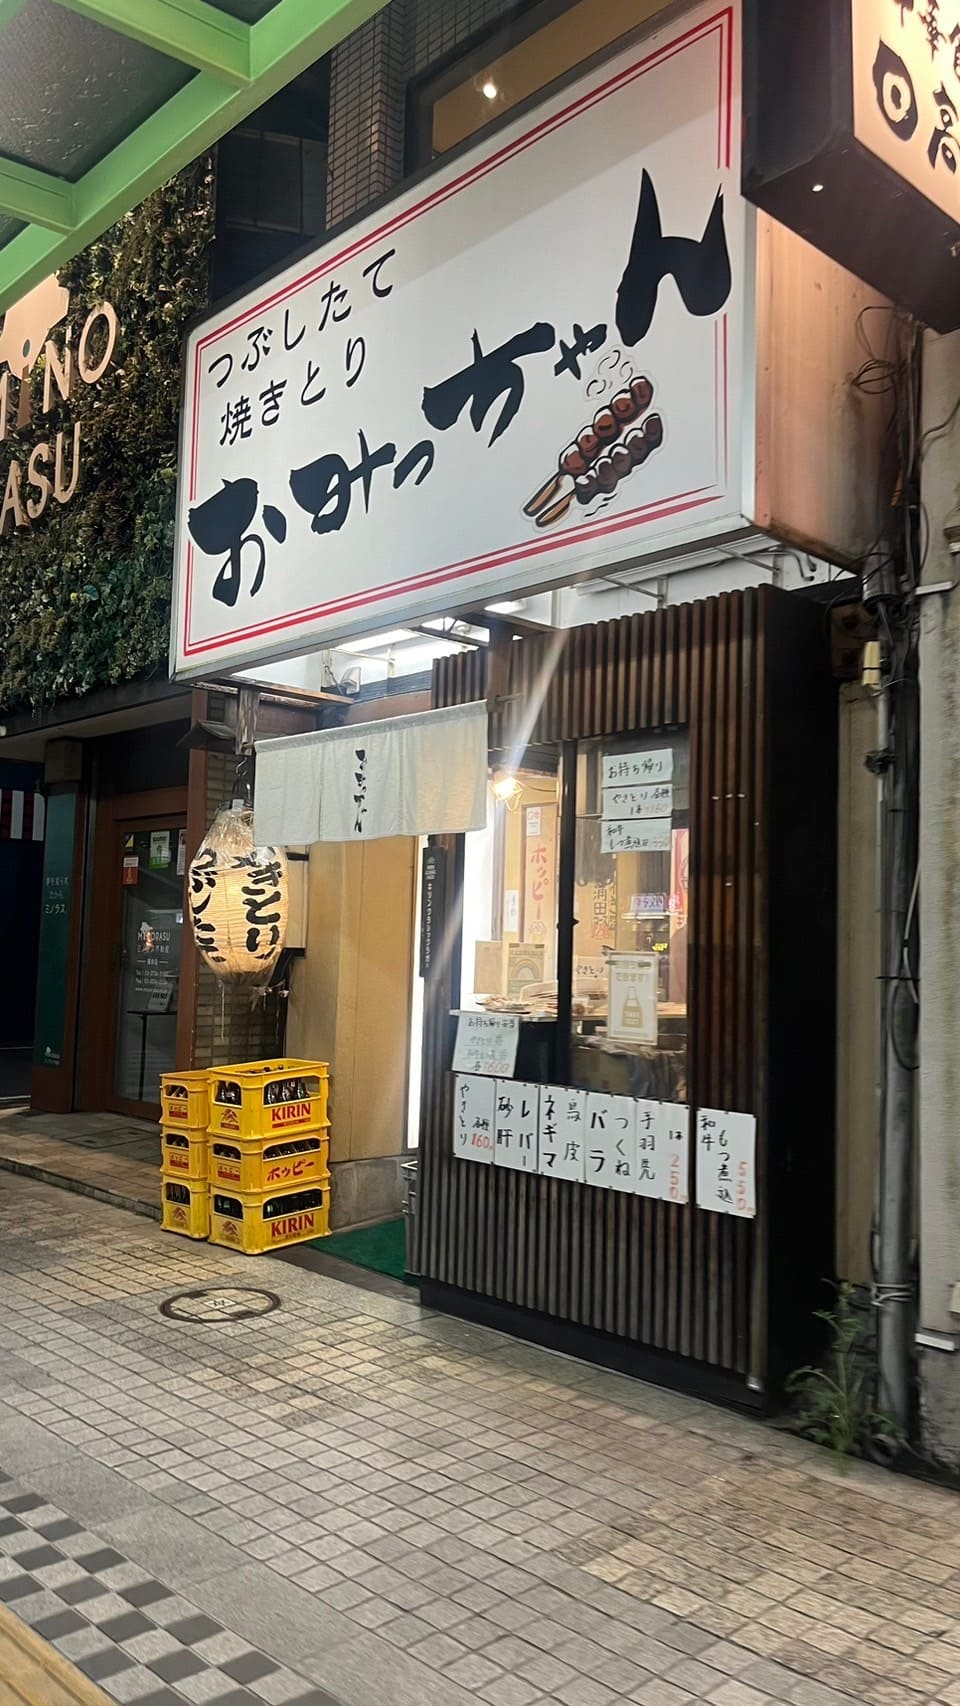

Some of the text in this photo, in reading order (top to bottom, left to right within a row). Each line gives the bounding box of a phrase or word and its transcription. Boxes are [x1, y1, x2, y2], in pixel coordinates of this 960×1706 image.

[208, 248, 397, 388] つぶしたて
[187, 167, 732, 608] おみっちゃん
[219, 336, 368, 447] 焼きとり
[608, 757, 663, 779] お持ち帰り
[530, 842, 549, 921] ホッピー
[271, 1102, 311, 1122] KIRIN
[496, 1096, 514, 1148] 砂肝
[519, 1100, 533, 1167] レバー
[542, 1095, 557, 1168] ネギマ
[589, 1109, 608, 1173] バラ
[700, 1115, 716, 1151] 和牛
[267, 1158, 315, 1182] ホッピー
[615, 1116, 631, 1176] つくね
[638, 1111, 656, 1181] 手羽先
[716, 1129, 734, 1205] もつ煮込
[271, 1212, 314, 1238] KIRIN
